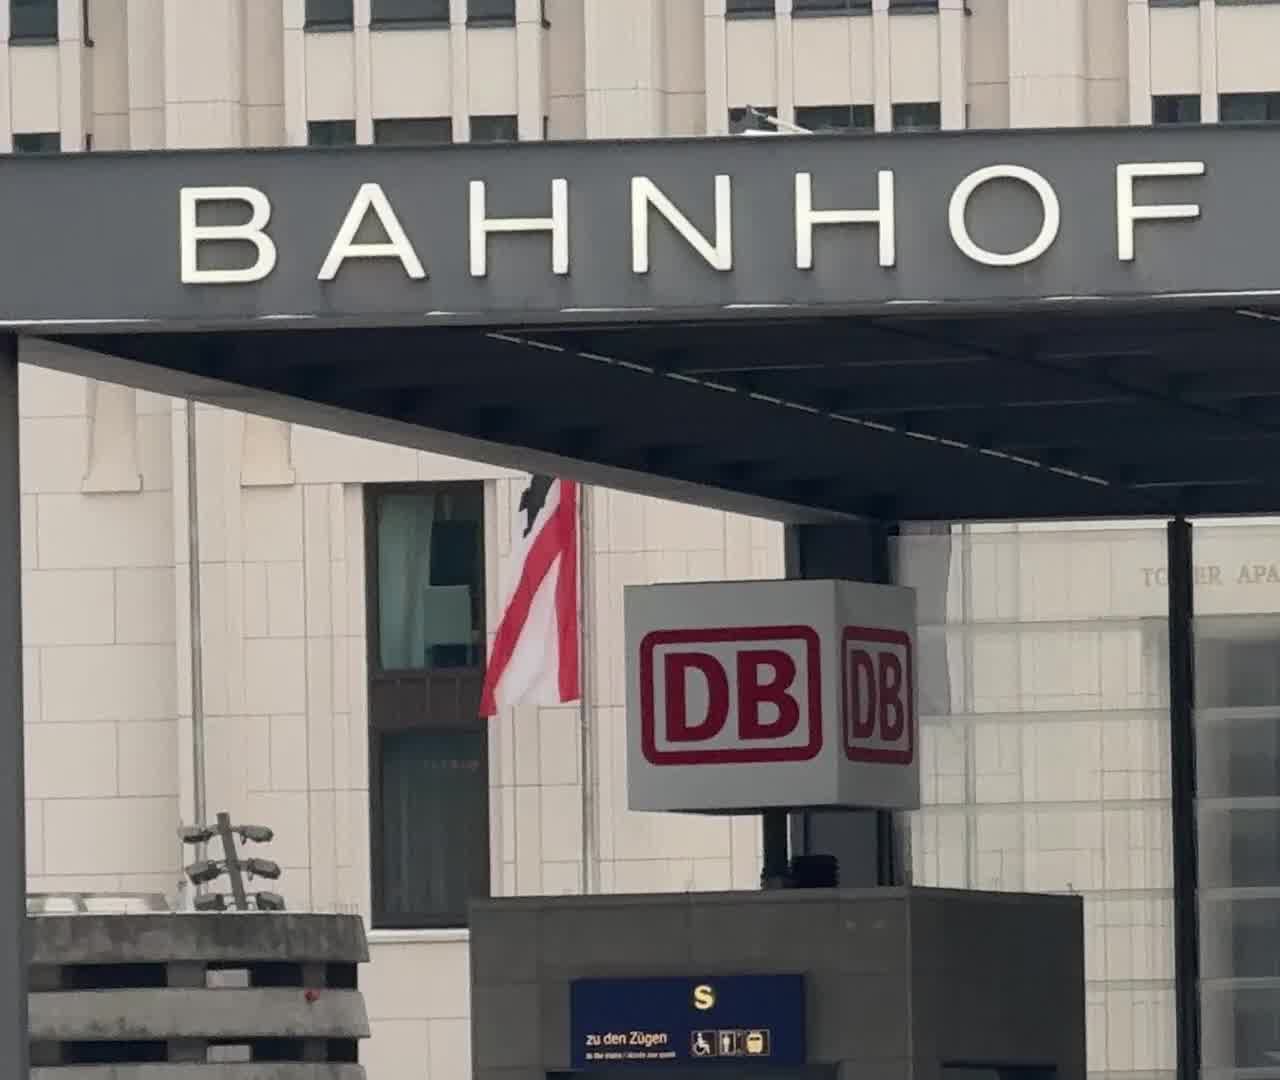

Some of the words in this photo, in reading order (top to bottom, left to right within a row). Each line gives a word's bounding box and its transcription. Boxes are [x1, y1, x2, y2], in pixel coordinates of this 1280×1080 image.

[179, 160, 1209, 286] BAHNHOF
[664, 649, 800, 742] DB
[849, 649, 905, 742] DB
[586, 1035, 601, 1046] zu
[603, 1032, 627, 1046] den
[629, 1030, 668, 1048] Zügen
[693, 984, 715, 1010] S
